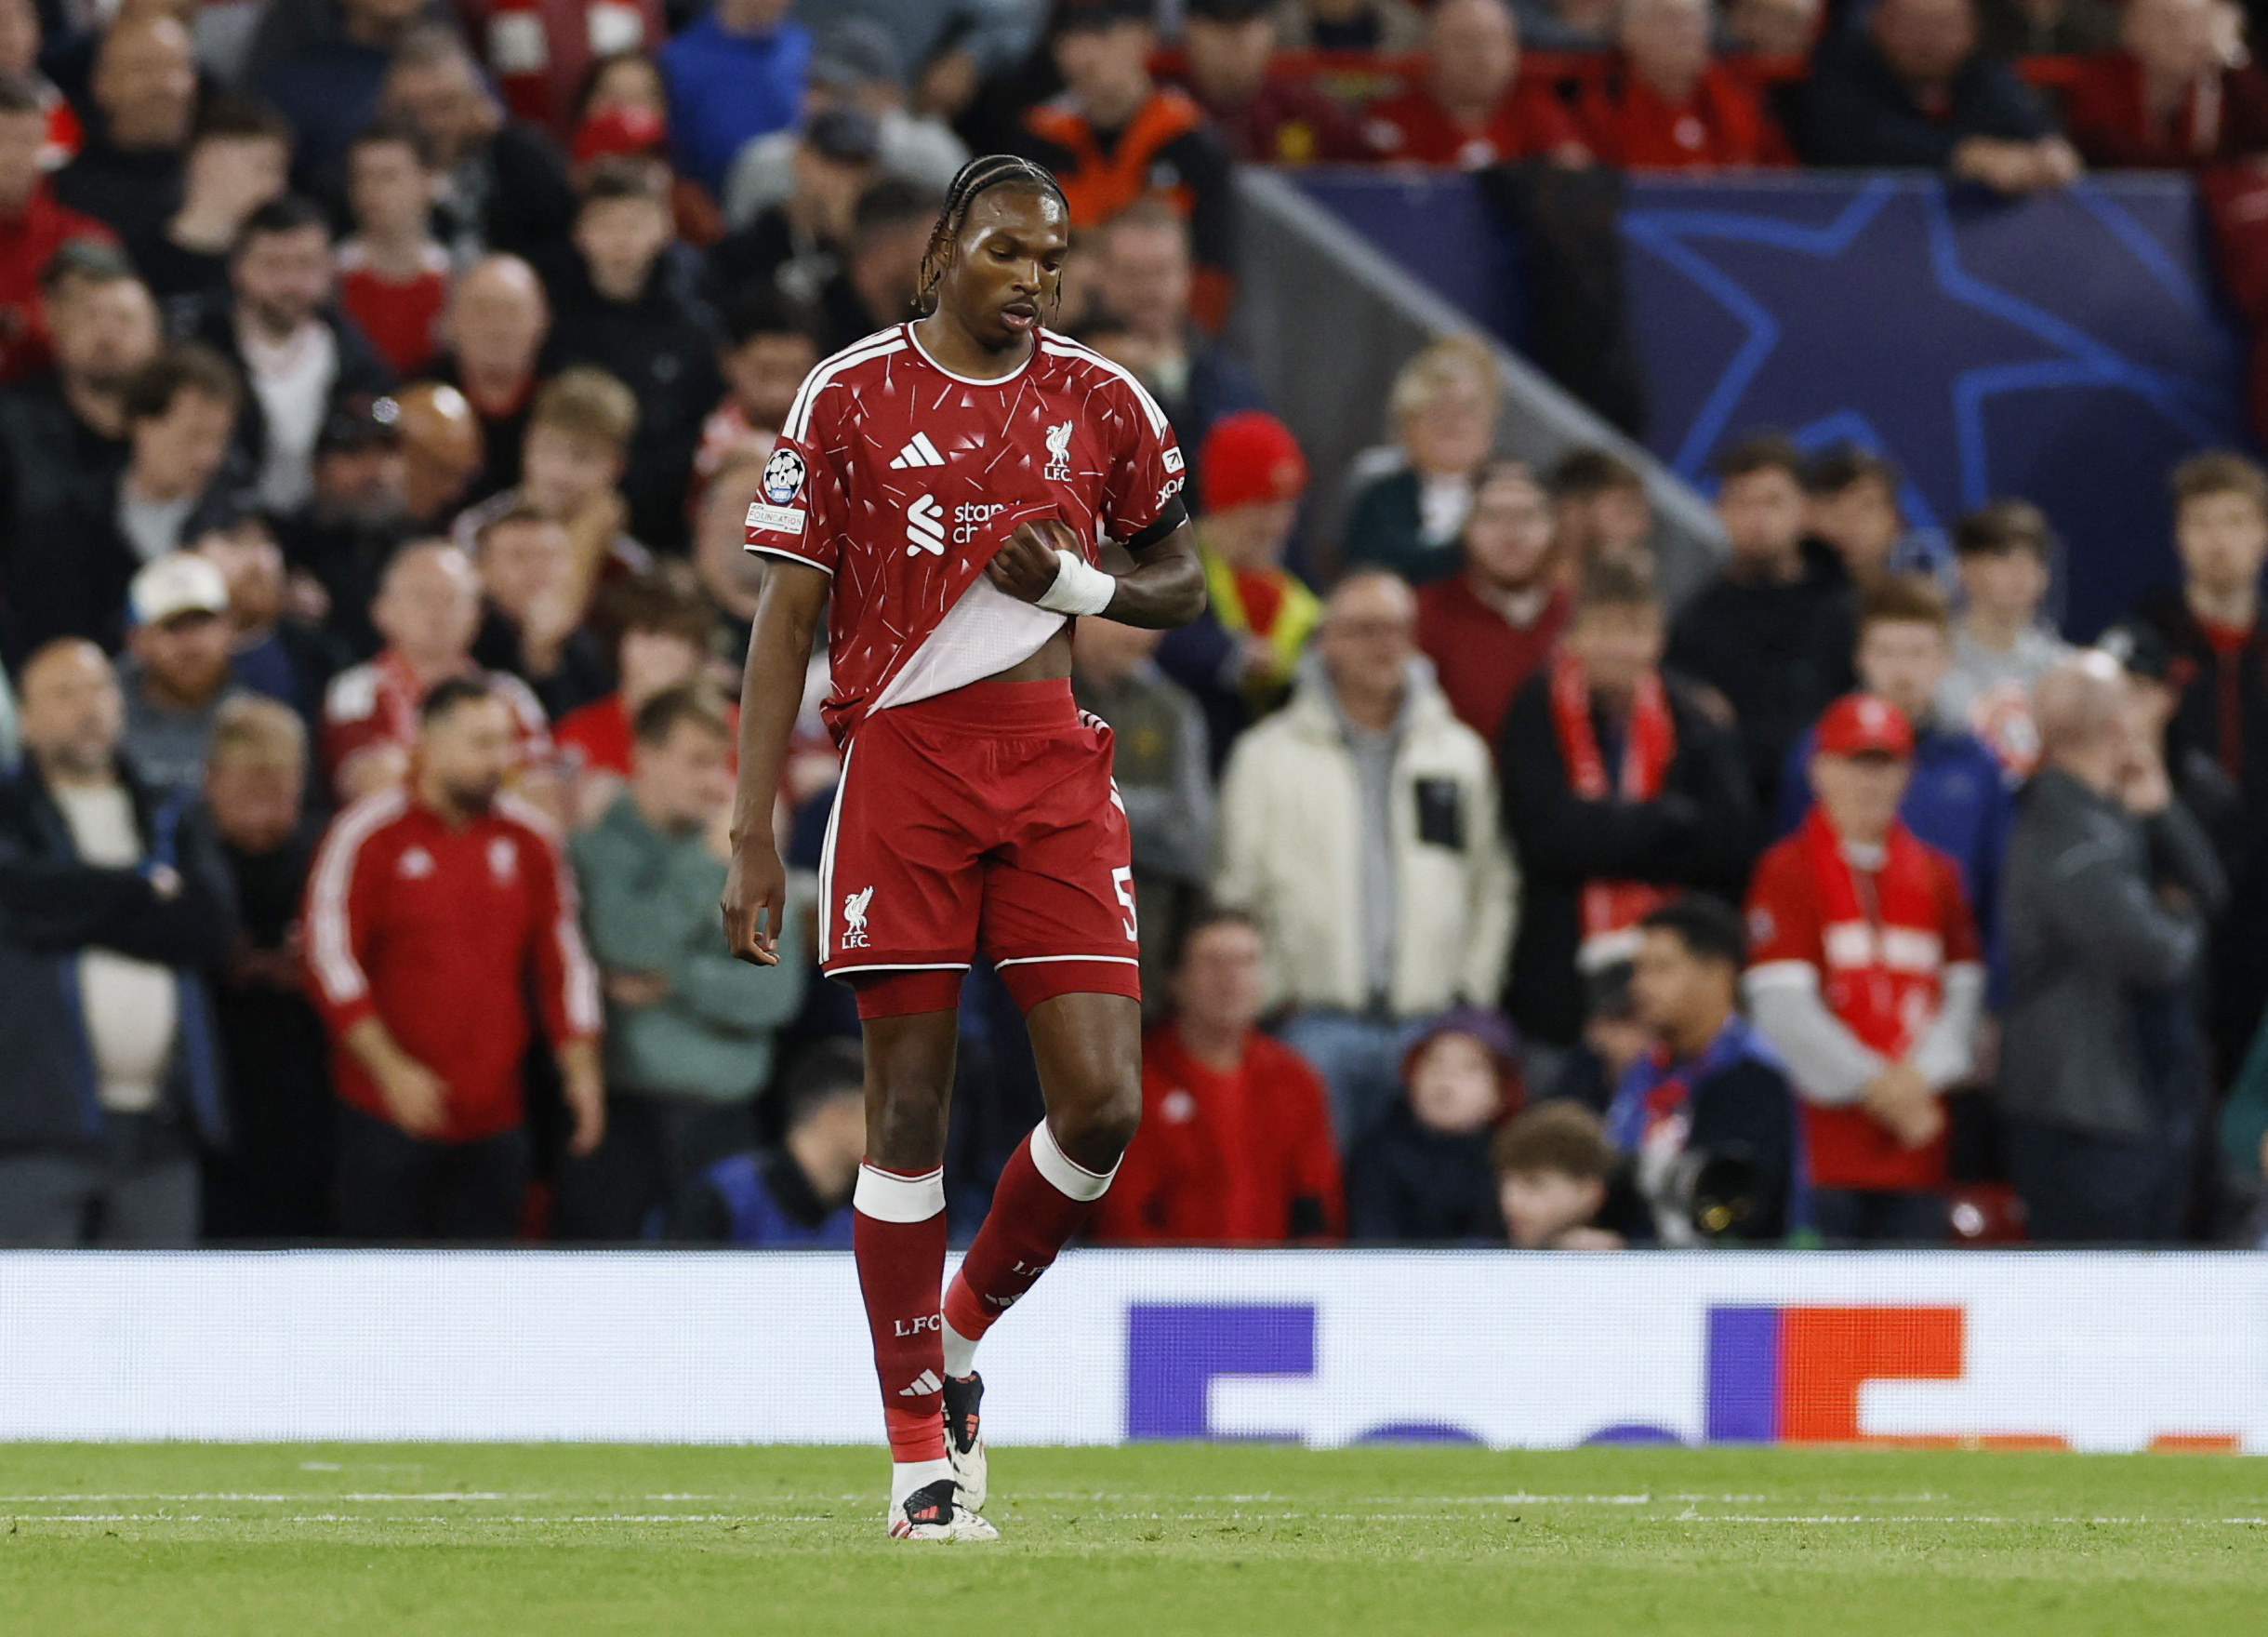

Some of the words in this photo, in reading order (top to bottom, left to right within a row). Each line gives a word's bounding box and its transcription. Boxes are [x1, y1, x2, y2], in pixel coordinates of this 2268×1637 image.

[749, 511, 802, 526] FOUNDATION
[1012, 1259, 1052, 1276] LF
[894, 1313, 941, 1338] LFC
